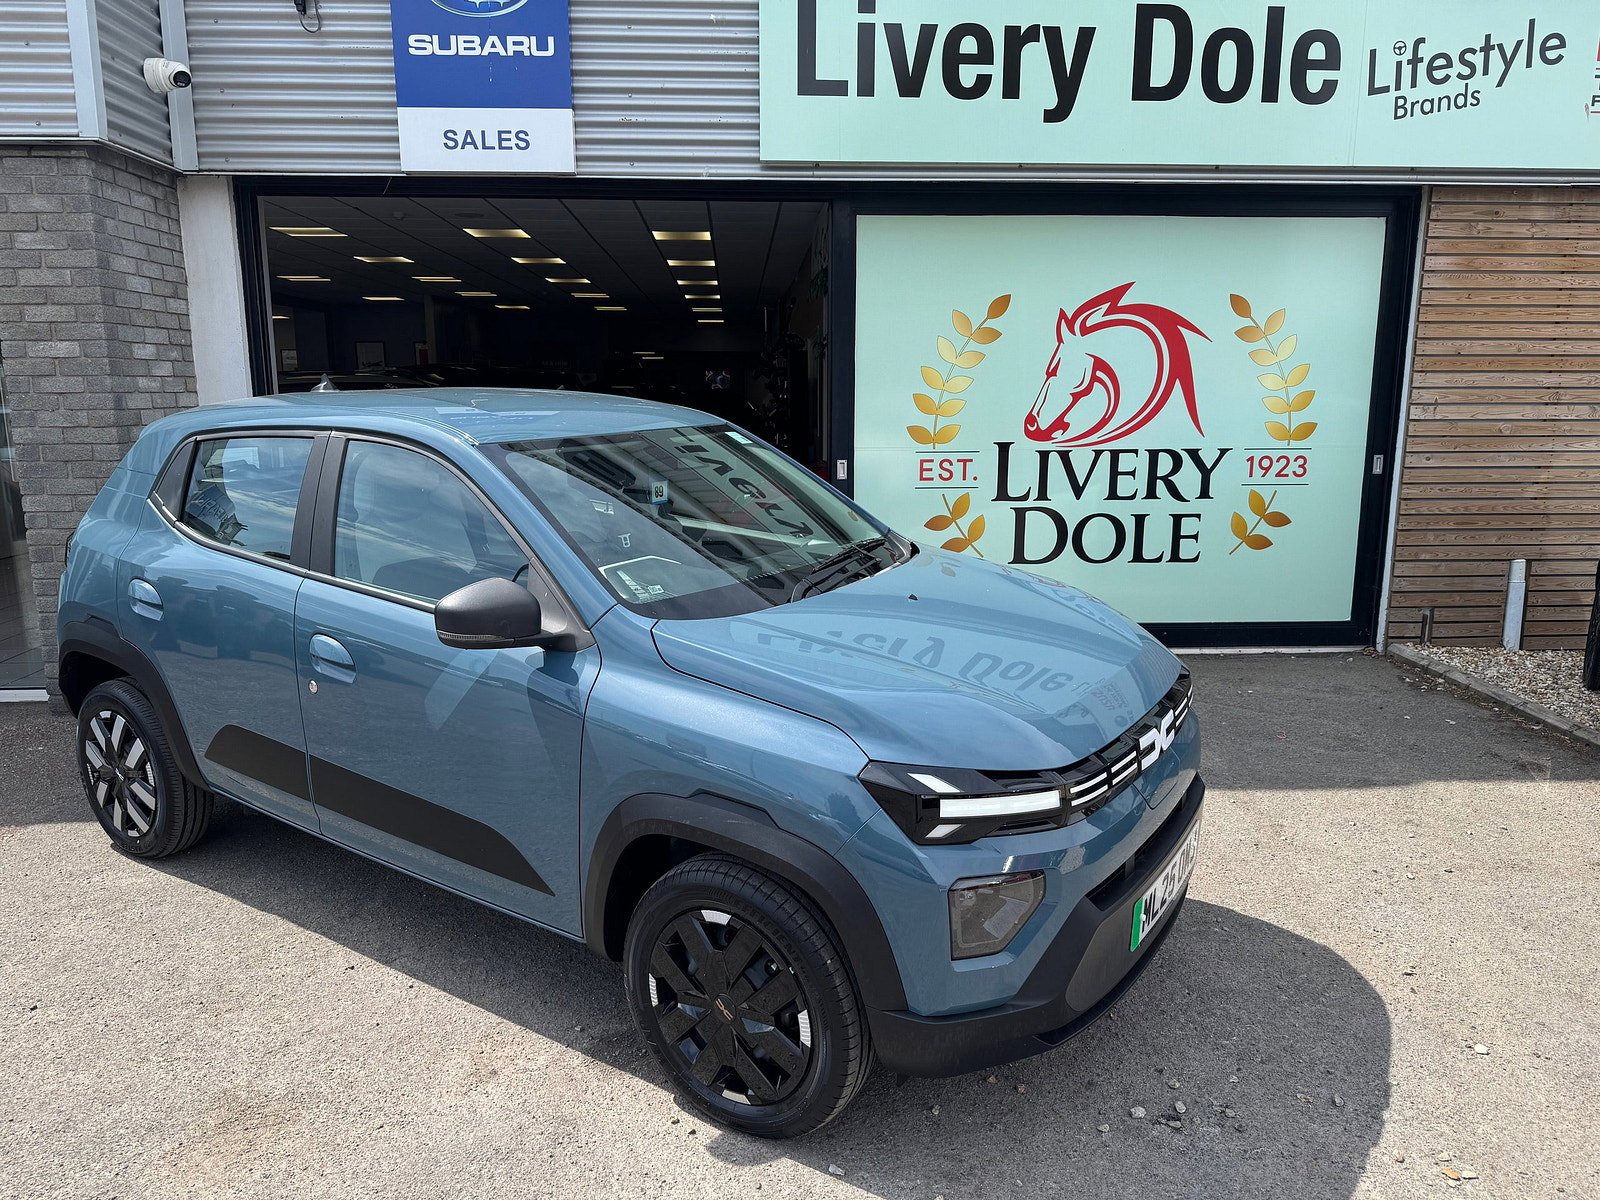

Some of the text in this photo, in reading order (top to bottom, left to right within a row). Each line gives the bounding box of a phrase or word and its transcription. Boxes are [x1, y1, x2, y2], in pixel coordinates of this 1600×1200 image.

[408, 34, 555, 57] SUBARU
[1367, 18, 1567, 96] Lifestyle
[796, 0, 1342, 124] Livery Dole
[1393, 83, 1481, 120] Brands
[443, 129, 531, 151] SALES
[919, 458, 978, 481] EST.
[990, 442, 1233, 503] LIVERY
[1246, 455, 1308, 478] 1923
[654, 485, 664, 498] 89
[1007, 507, 1202, 565] DOLE
